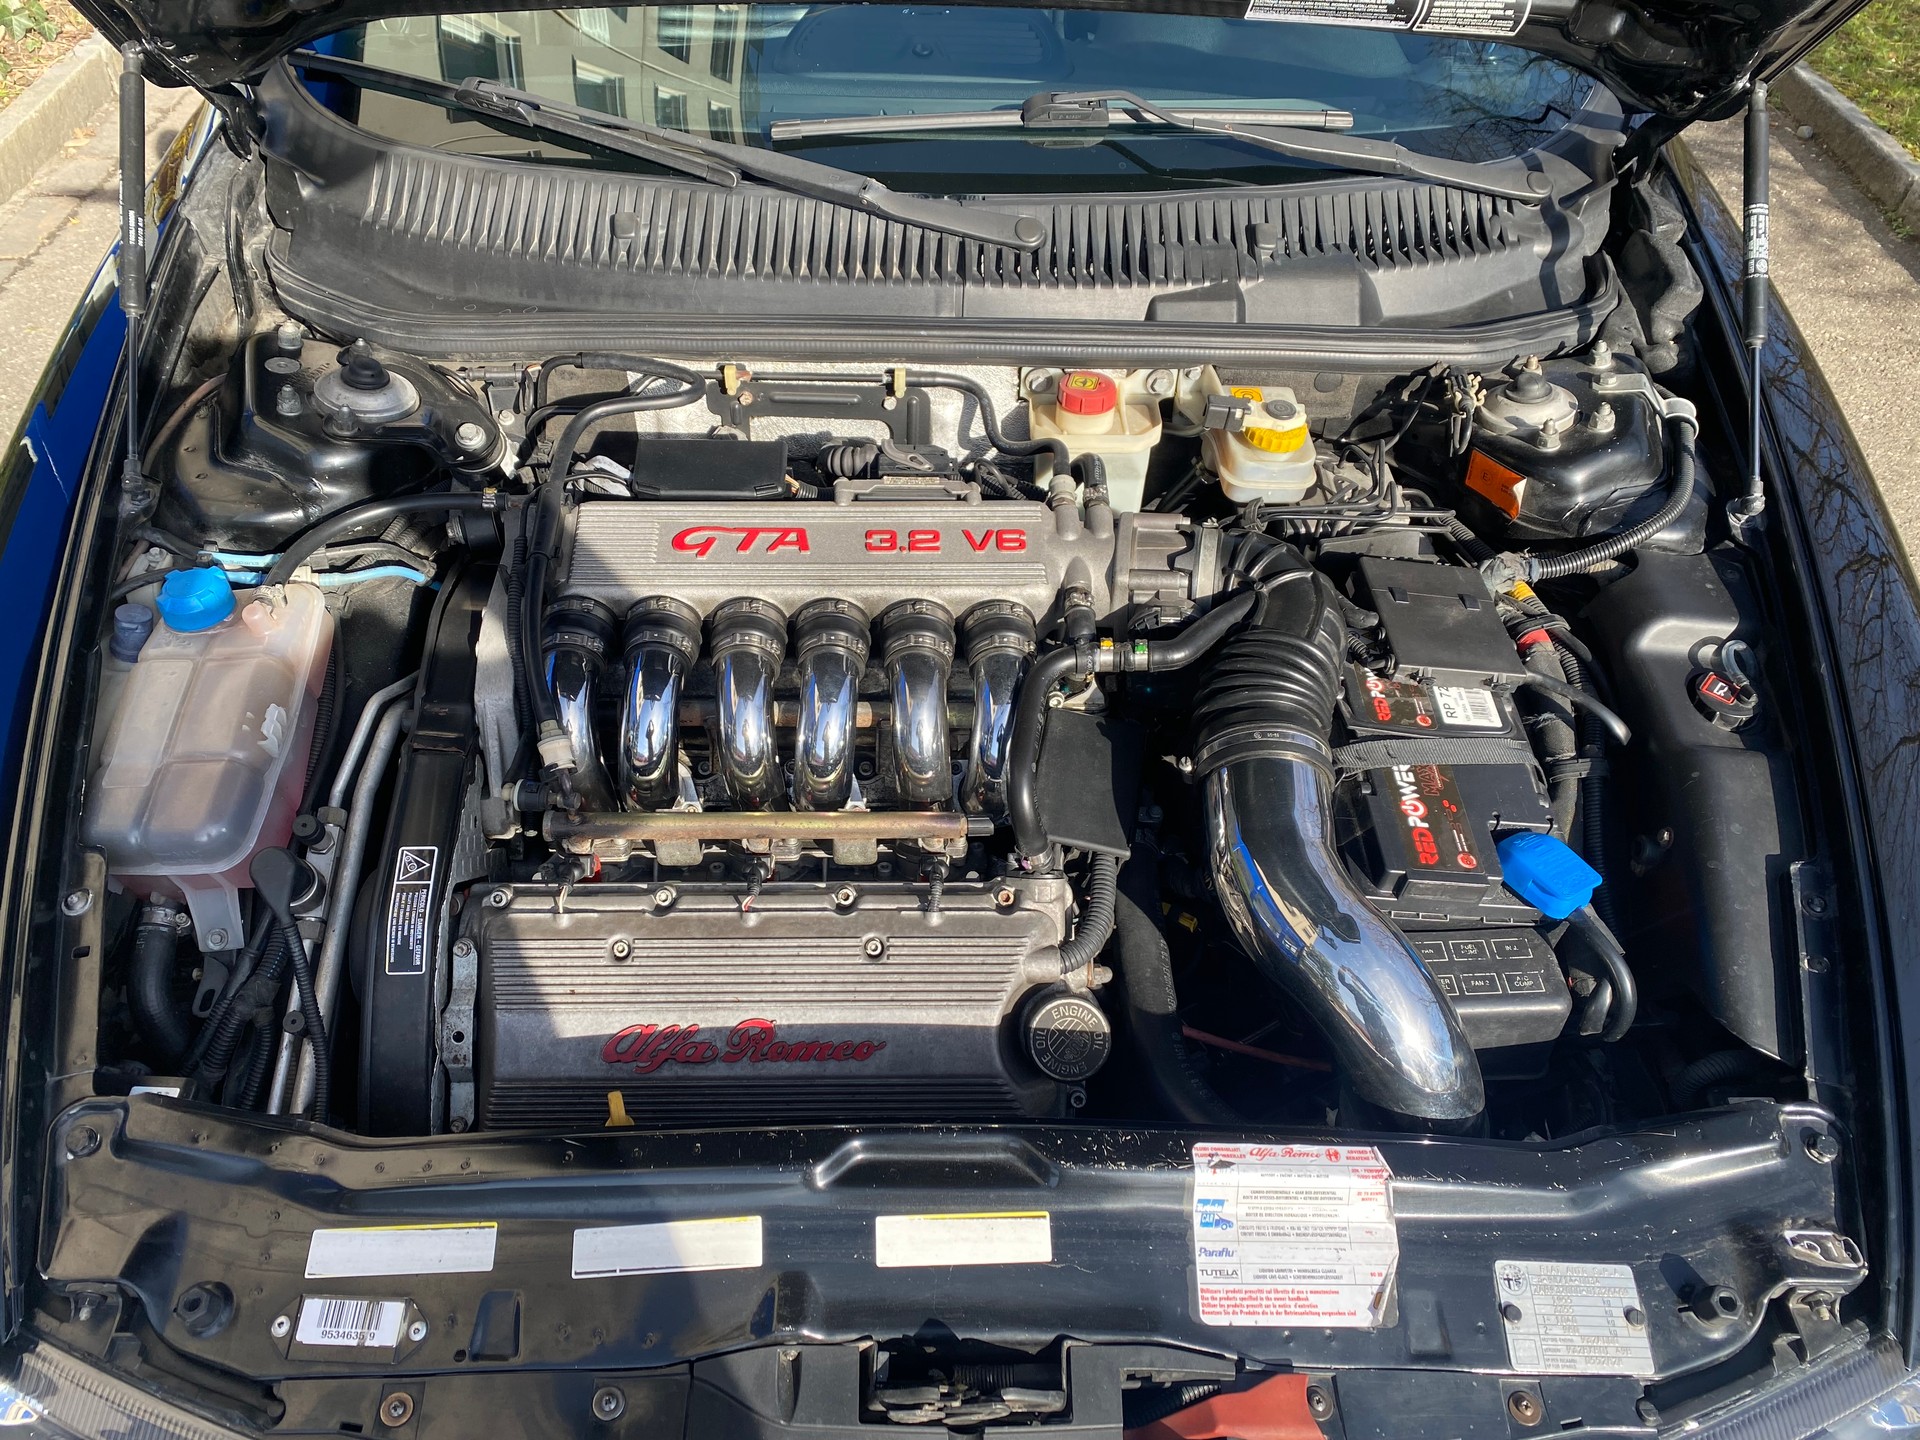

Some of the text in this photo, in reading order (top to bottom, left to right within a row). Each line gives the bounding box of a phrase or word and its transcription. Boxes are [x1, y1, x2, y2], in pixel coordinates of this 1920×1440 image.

[672, 526, 1027, 560] GTA 3.2 V6
[1443, 703, 1458, 718] RP
[415, 919, 423, 939] DANGER
[1052, 1005, 1098, 1028] ENGINE
[1093, 1031, 1104, 1050] OIL
[601, 1017, 887, 1073] Alfa Romeo
[1036, 1029, 1047, 1049] OIL
[1041, 1052, 1087, 1074] ENGINE
[1250, 1147, 1322, 1162] Alfa Romeo
[1202, 1213, 1214, 1223] CAR
[1198, 1247, 1235, 1258] Paraflu
[1200, 1269, 1239, 1277] TUTELA
